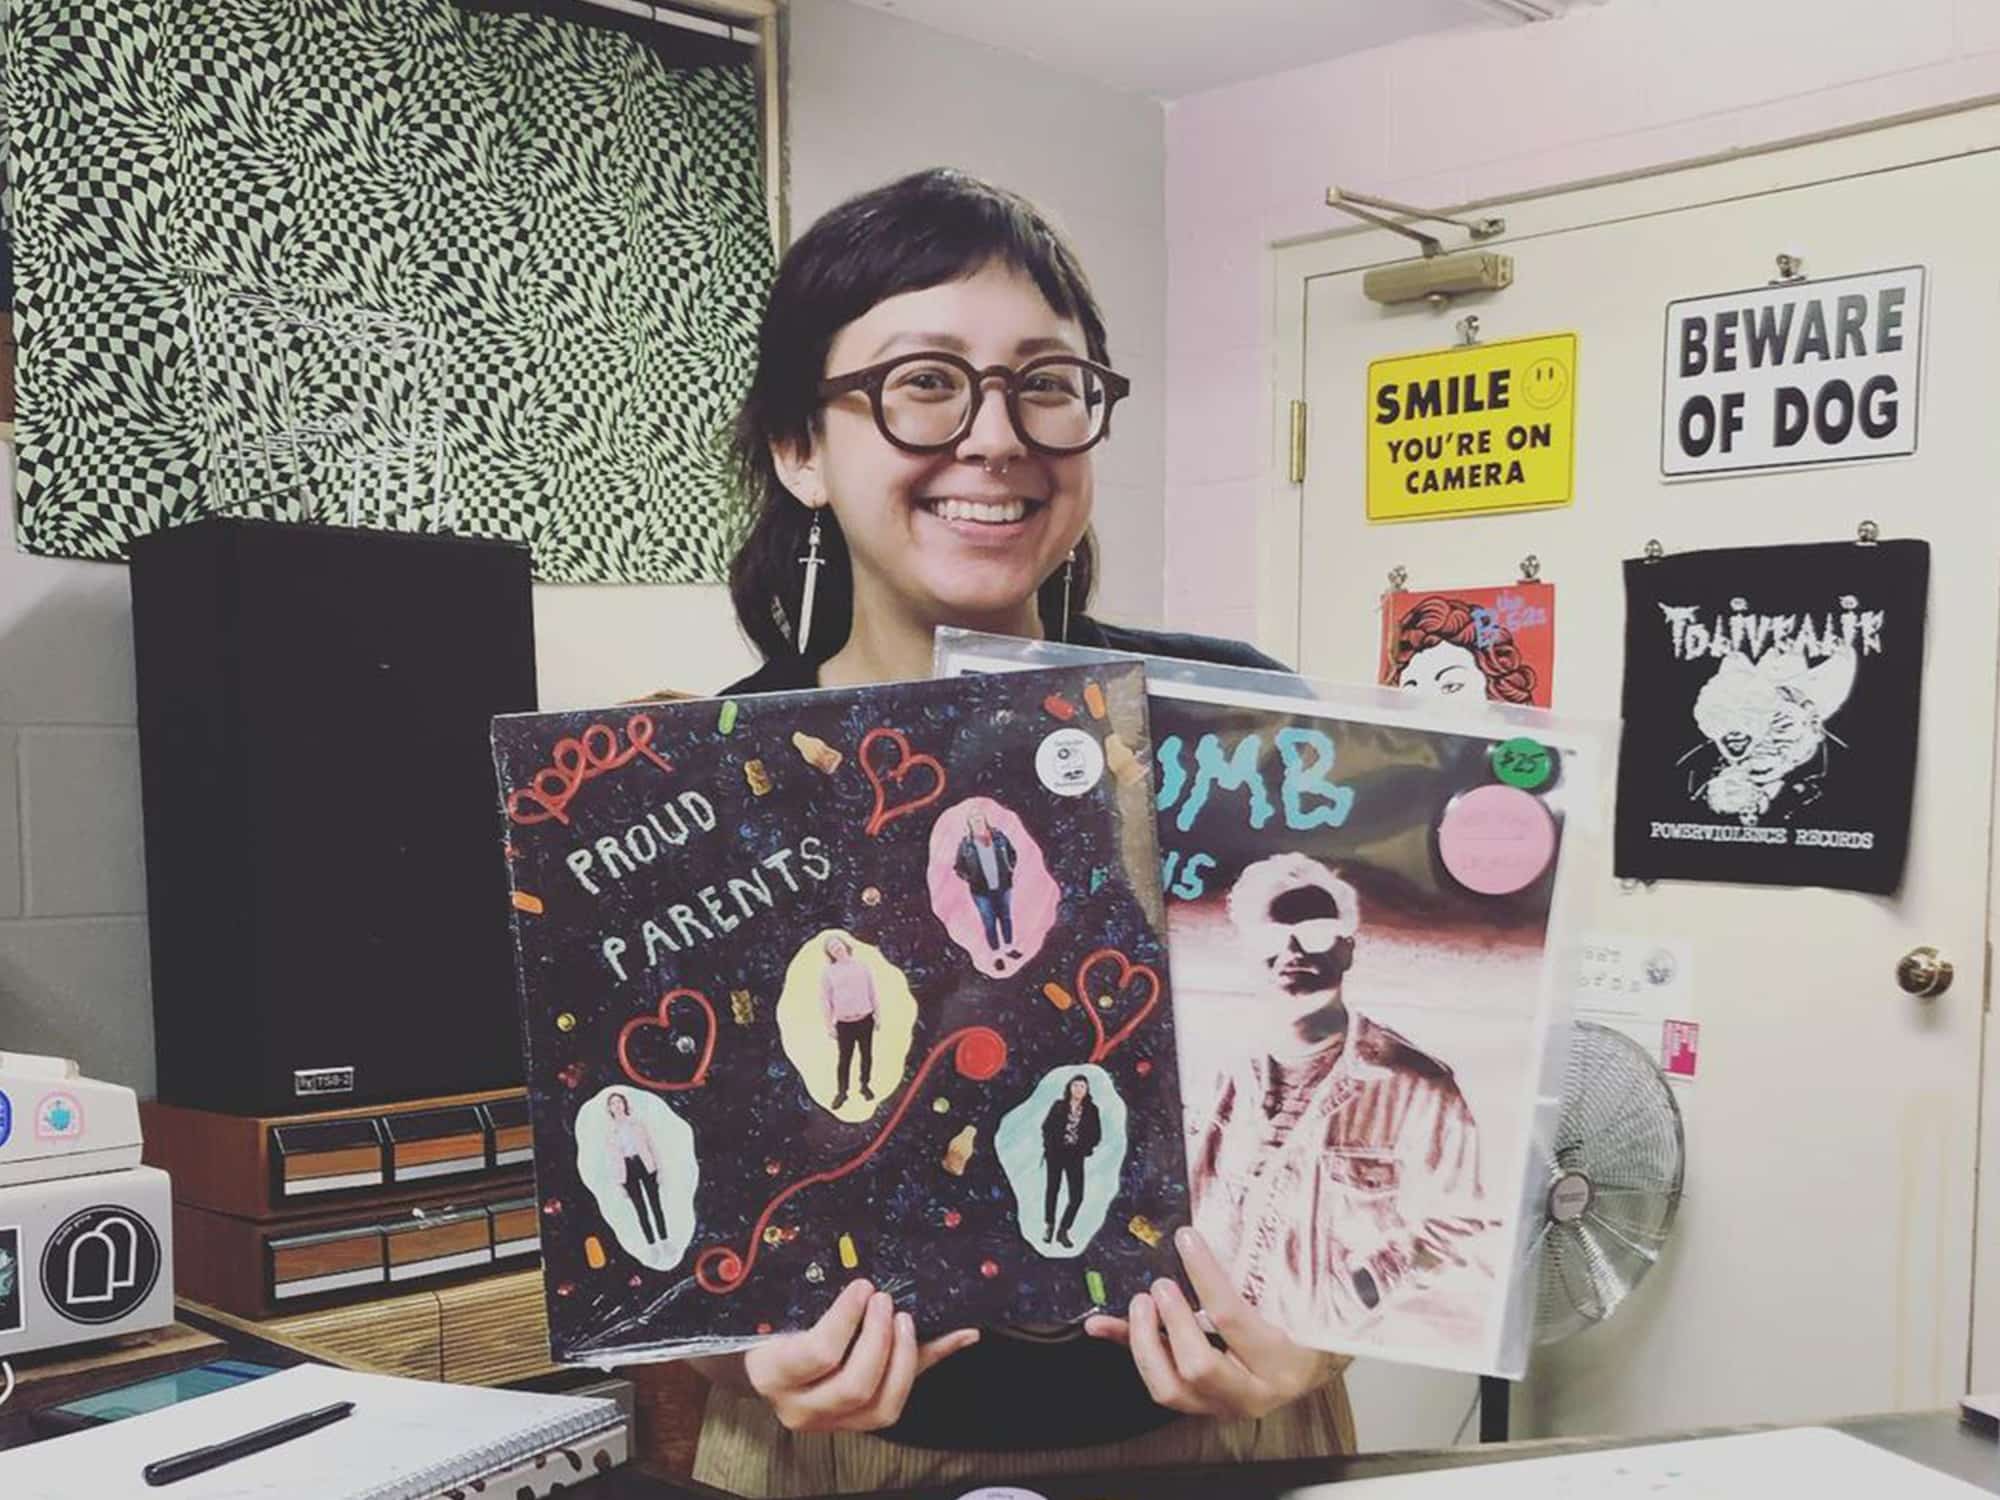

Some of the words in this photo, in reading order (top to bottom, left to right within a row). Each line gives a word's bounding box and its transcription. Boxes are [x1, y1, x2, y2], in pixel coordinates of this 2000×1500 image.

[1680, 287, 1906, 377] BEWARE
[1375, 370, 1511, 424] SMILE
[1679, 391, 1745, 457] OF
[1774, 374, 1899, 448] DOG
[1387, 433, 1491, 464] YOU'RE
[1506, 424, 1552, 449] ON
[1406, 461, 1525, 495] CAMERA
[1498, 750, 1546, 774] $25
[566, 791, 717, 894] PROUD
[1650, 822, 1787, 844] POWERVIOLENCE
[1794, 829, 1875, 849] RECORDS
[602, 836, 833, 980] PARENTS
